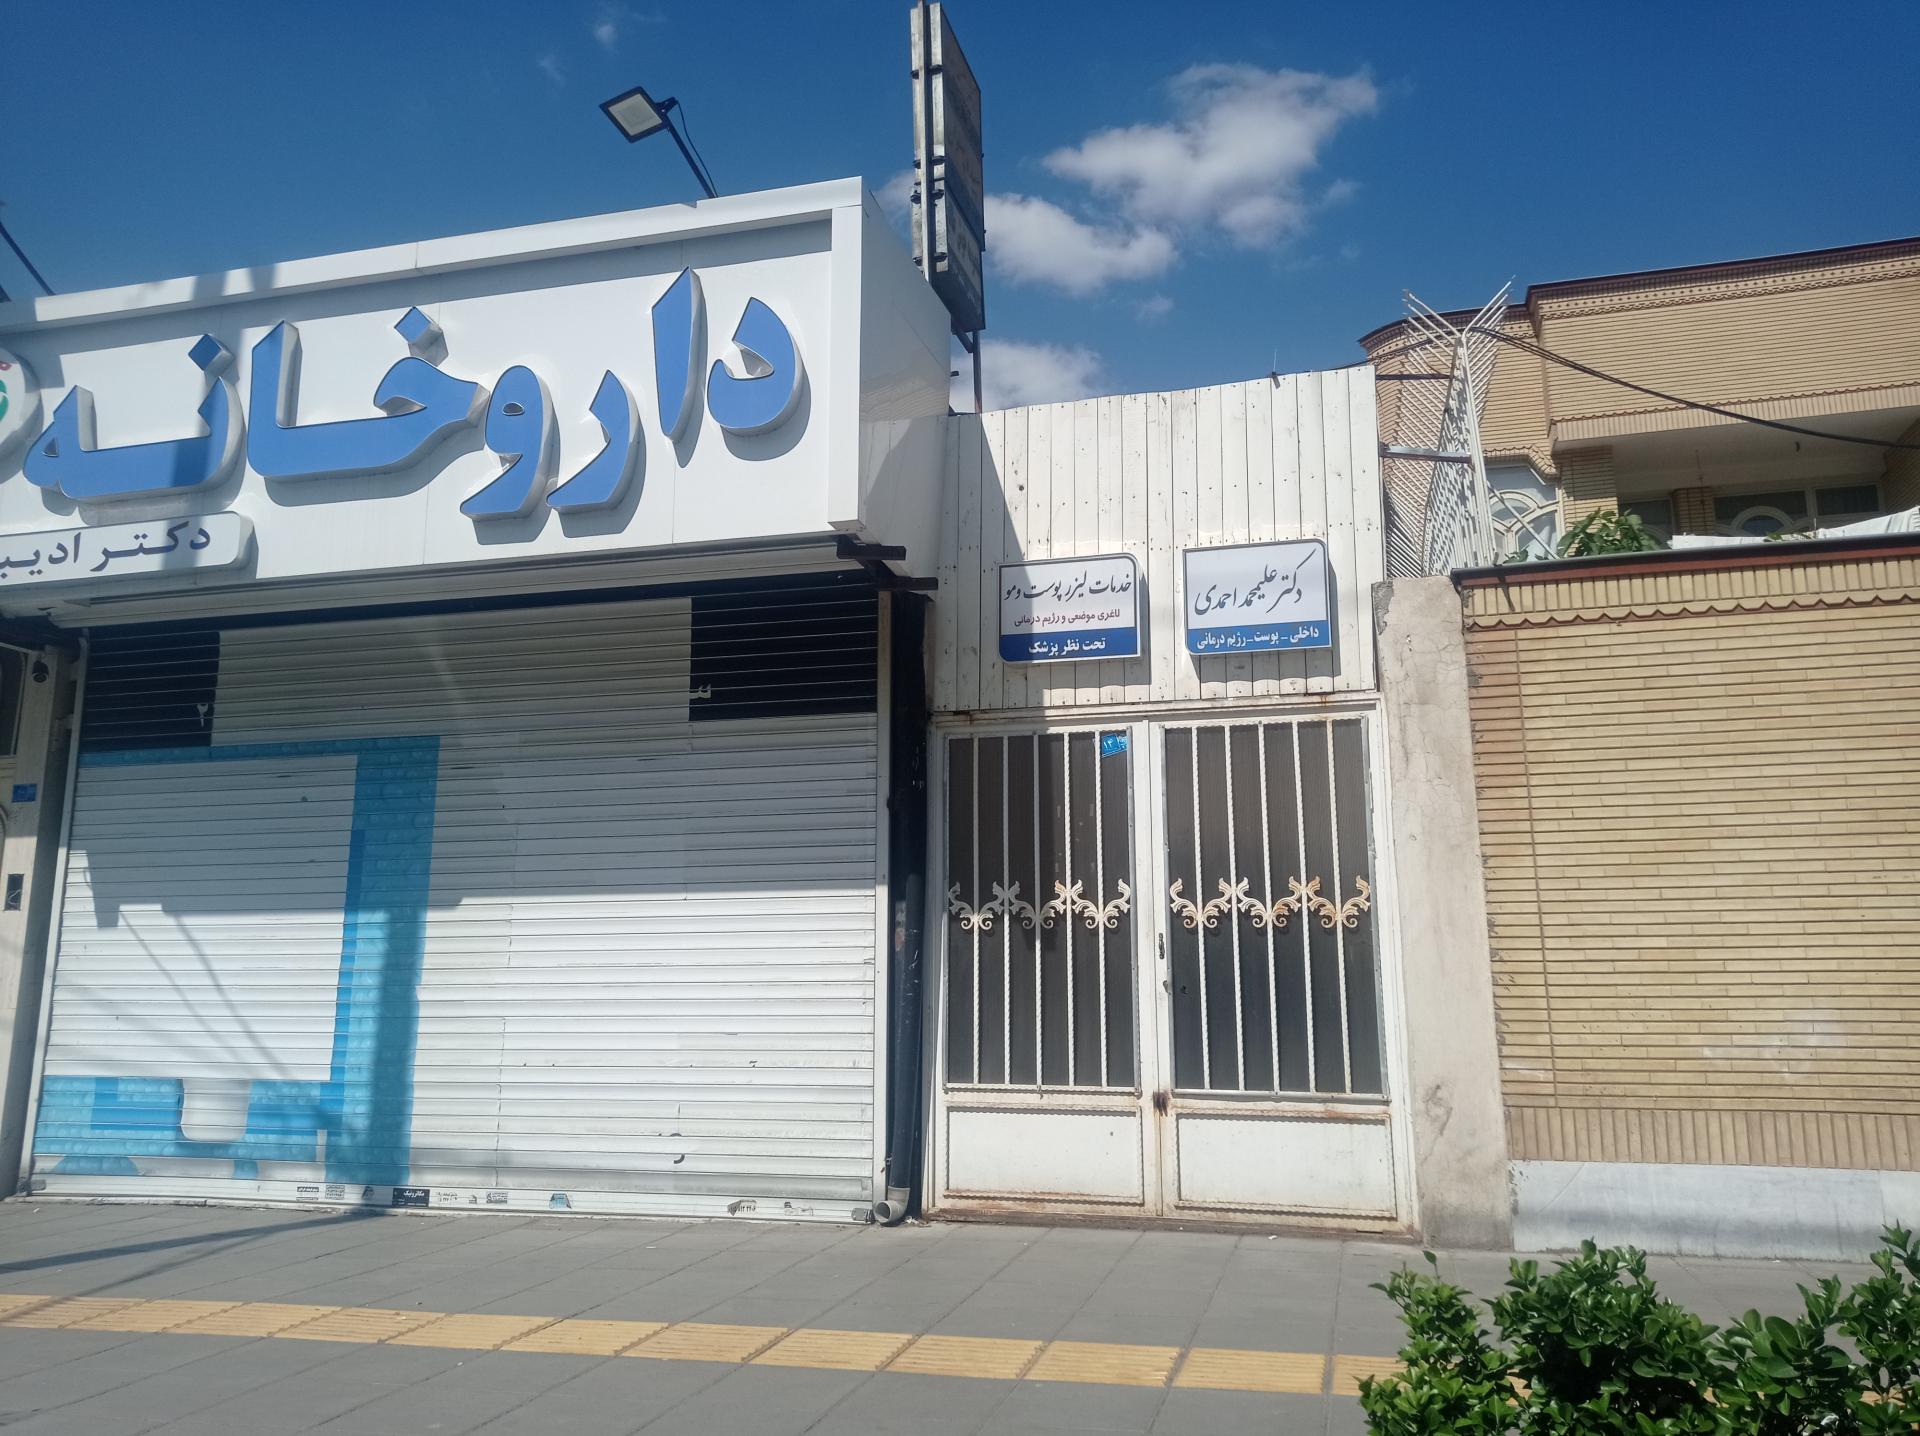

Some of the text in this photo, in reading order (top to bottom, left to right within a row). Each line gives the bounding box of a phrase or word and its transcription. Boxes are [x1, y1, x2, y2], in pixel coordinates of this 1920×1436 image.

[22, 266, 801, 518] داروخانه
[0, 520, 211, 579] دکتر ادیب
[1023, 580, 1061, 602] پوست
[1065, 569, 1087, 602] لیزر
[1089, 573, 1131, 594] خدمات
[1266, 549, 1316, 613] دکتر
[1194, 584, 1237, 615] احمدی
[1014, 614, 1040, 627] درمانی
[1042, 612, 1060, 627] رژیم
[1068, 610, 1096, 624] موضعی
[1097, 608, 1120, 621] لاغری
[1196, 631, 1225, 649] درمانی
[1289, 625, 1319, 643] داخلی
[1028, 637, 1106, 656] تحت نظر پزشک
